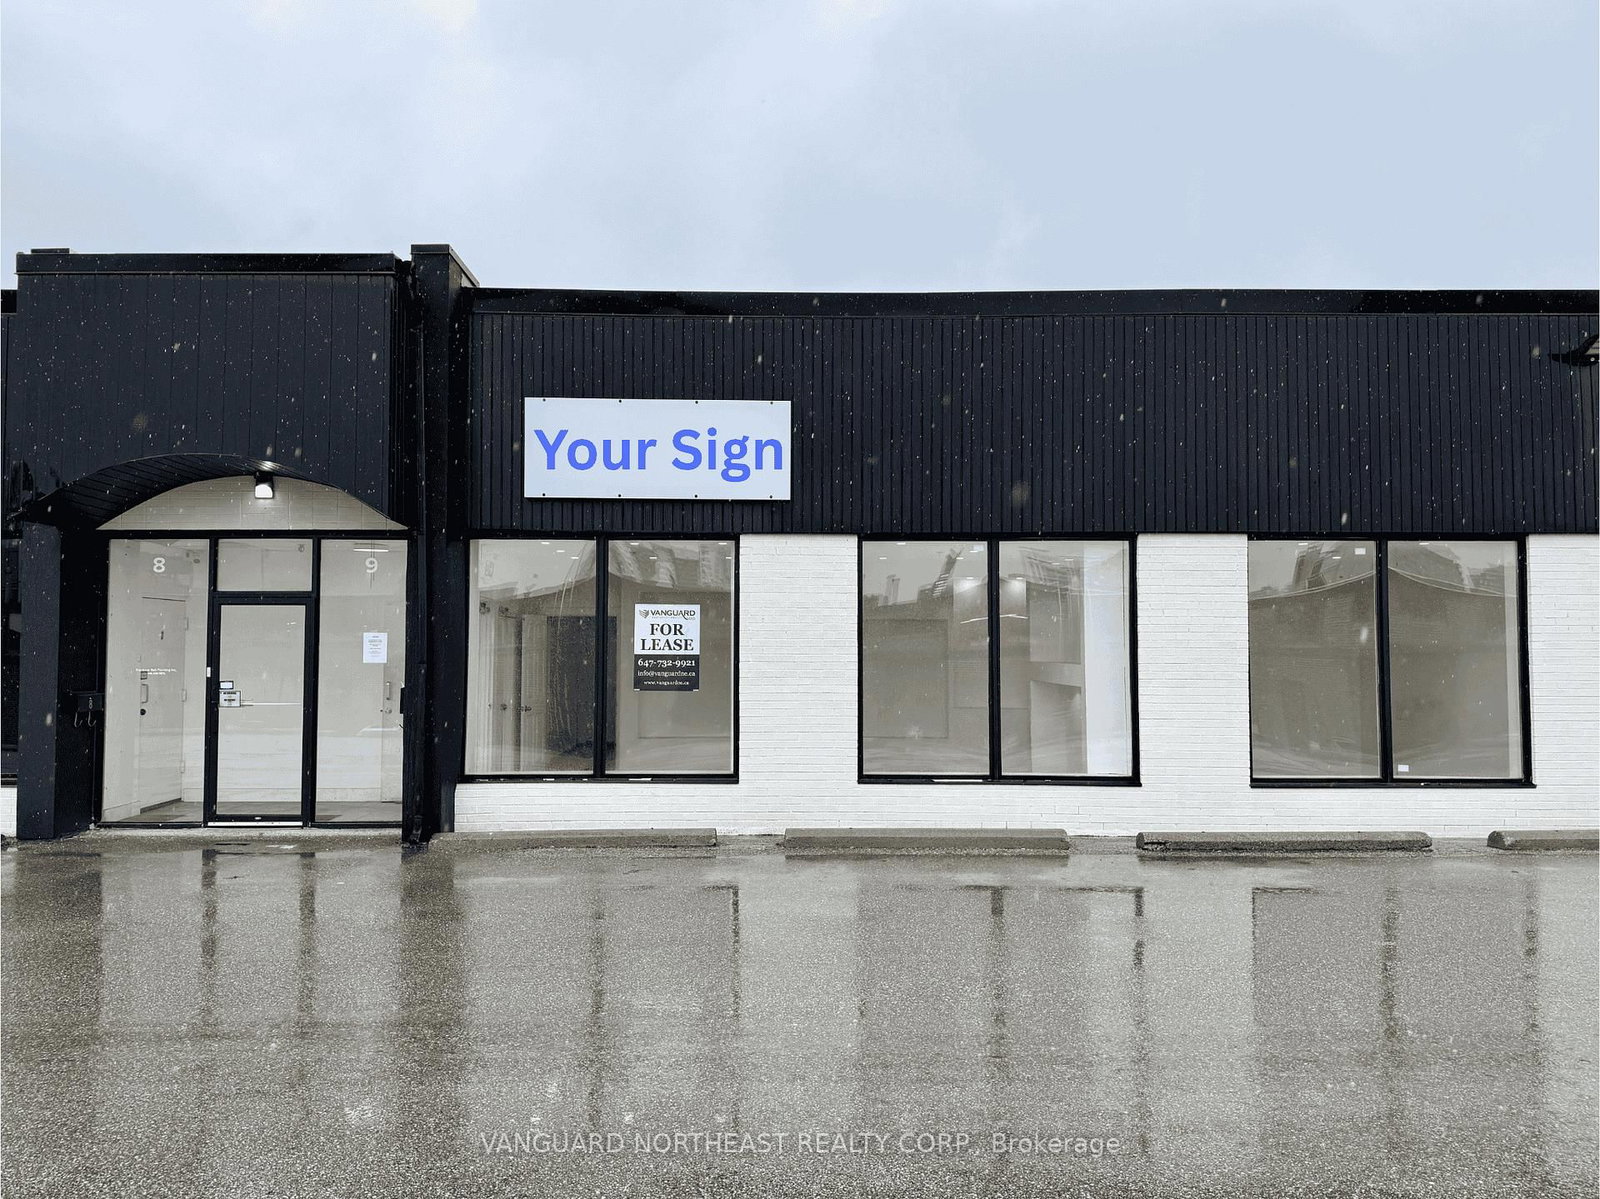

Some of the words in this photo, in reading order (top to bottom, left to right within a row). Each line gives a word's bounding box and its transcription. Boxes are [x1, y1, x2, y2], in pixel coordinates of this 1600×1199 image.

[533, 429, 657, 471] Your
[671, 427, 783, 482] Sign
[152, 557, 166, 573] 8
[365, 557, 378, 573] 9
[650, 609, 696, 619] VANGUARD
[649, 623, 685, 636] FOR
[640, 638, 694, 651] LEASE
[637, 658, 696, 668] 647-732-9921
[637, 669, 696, 677] info@vanguardne.ca
